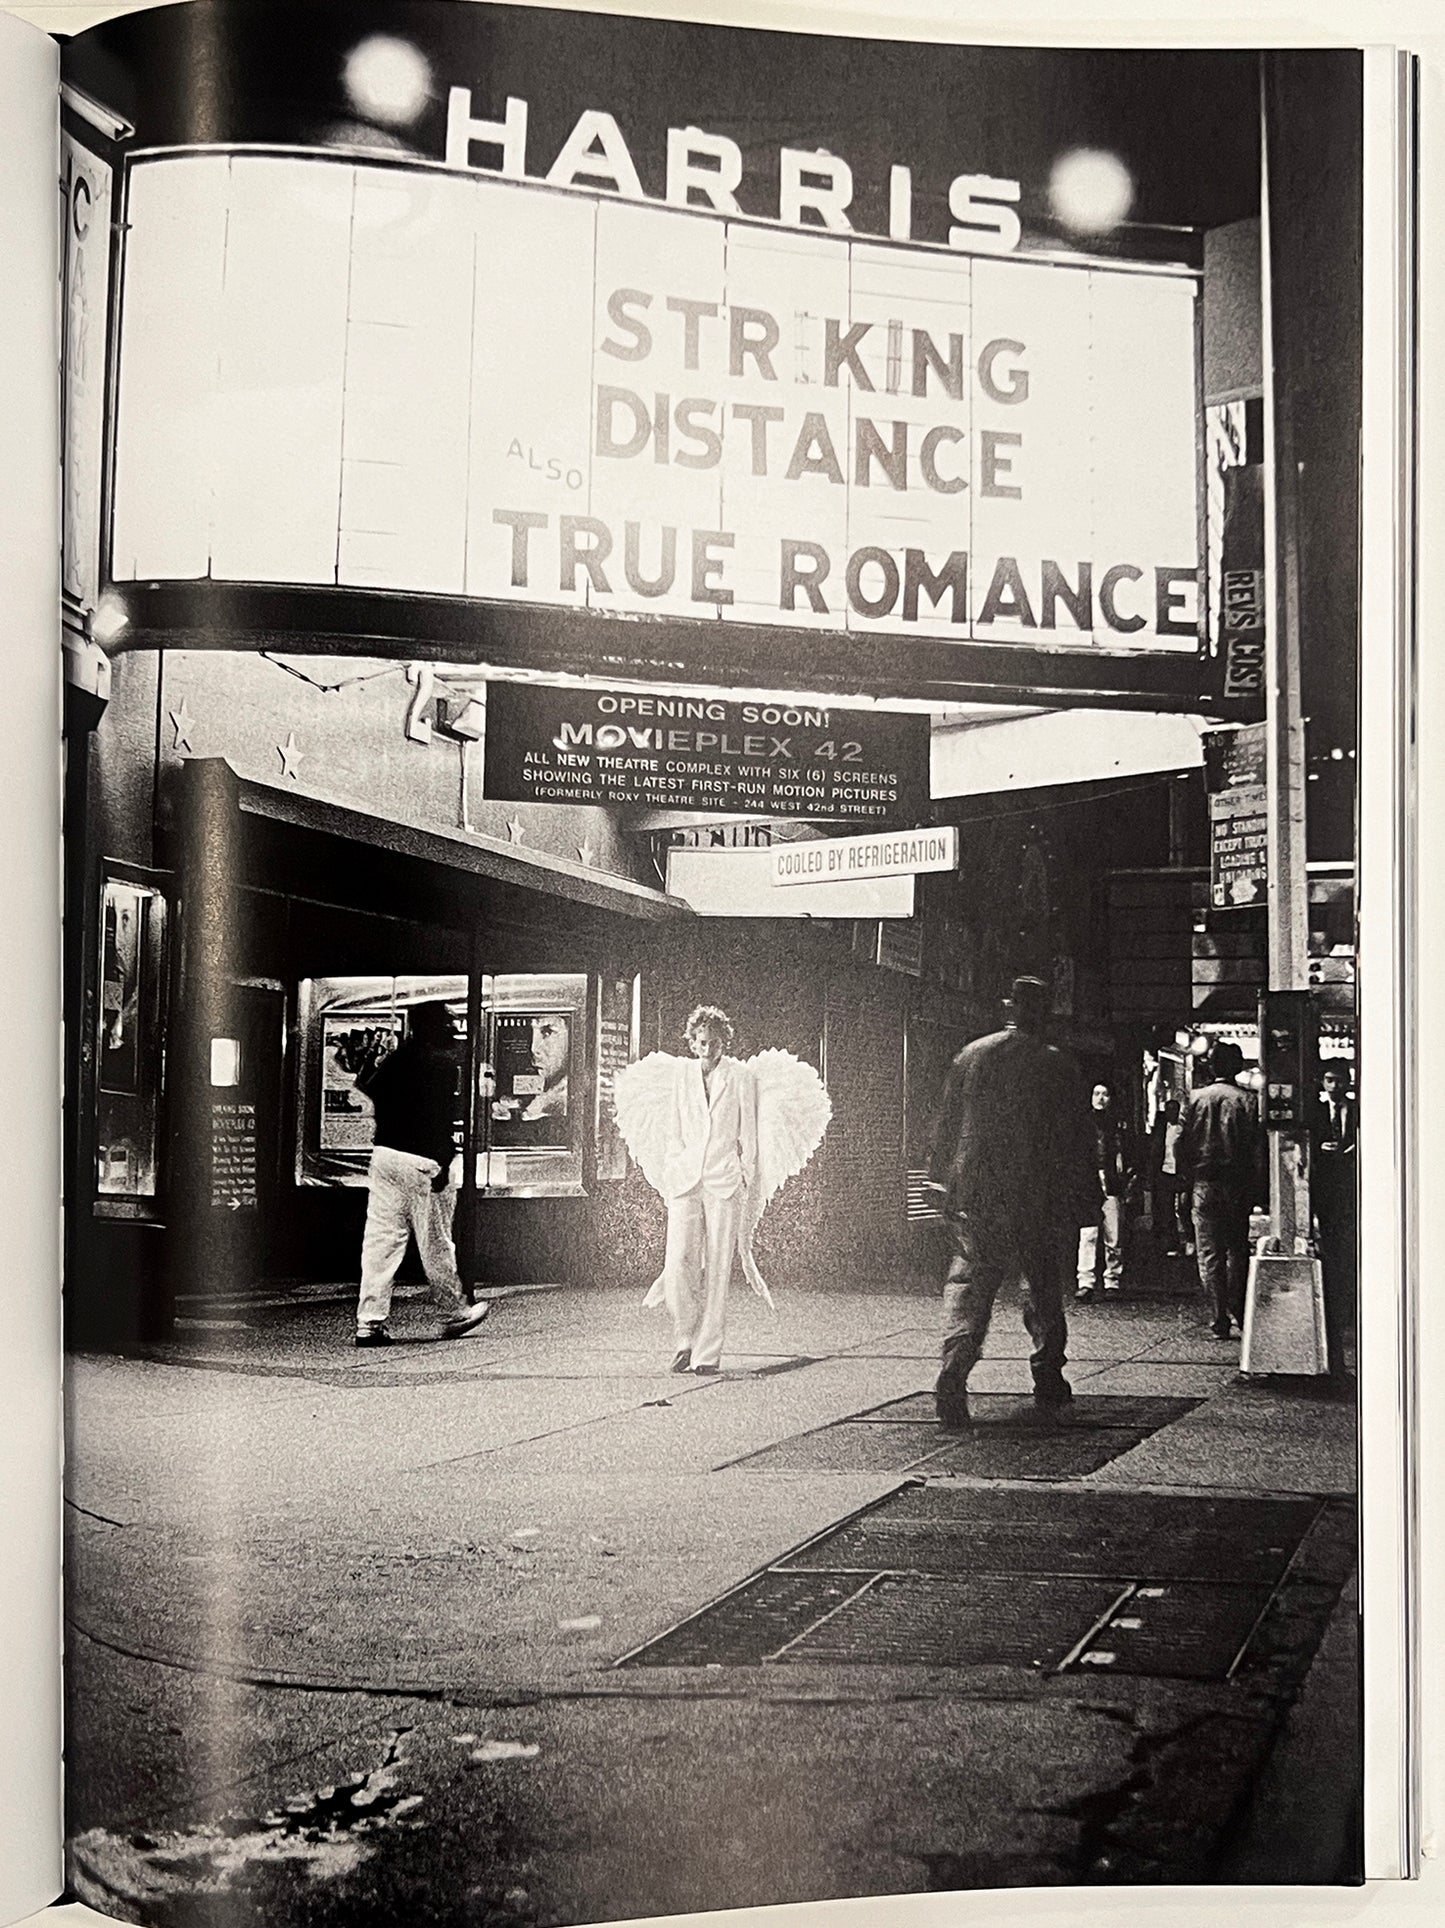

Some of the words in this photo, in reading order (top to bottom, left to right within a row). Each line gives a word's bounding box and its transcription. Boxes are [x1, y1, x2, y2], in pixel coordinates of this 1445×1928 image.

[445, 86, 1021, 252] HARRIS
[600, 288, 1029, 404] STRKING
[506, 437, 583, 490] ALSO
[595, 384, 1022, 499] DISTANCE
[493, 508, 736, 606] TRUE
[779, 538, 1198, 636] ROMANCE
[1227, 571, 1256, 628] REVS
[598, 696, 726, 721] OPENING
[742, 706, 829, 728] SOON!
[559, 722, 792, 758] MOVIEPLEX
[814, 740, 863, 763] 42
[523, 769, 592, 784] SHOWING
[600, 774, 625, 787] THE
[634, 776, 684, 790] LATEST
[692, 779, 766, 794] FIRST-RUN
[773, 784, 825, 798] MOTION
[832, 787, 897, 801] PICTURES
[524, 751, 549, 764] ALL
[557, 753, 590, 767] NEW
[597, 756, 658, 771] THEATRE
[666, 761, 731, 776] COMPLEX
[738, 765, 771, 778] WITH
[778, 768, 799, 780] SIX
[806, 769, 826, 782] (6)
[833, 771, 897, 785] SCREENS
[535, 786, 602, 800] (FORMERLY
[608, 791, 640, 802] ROXY
[646, 793, 695, 806] THEATRE
[702, 797, 726, 807] SITE
[770, 801, 801, 812] WEST
[806, 803, 835, 813] 42nd
[840, 804, 887, 816] STREET)
[777, 852, 823, 876] COOLED
[828, 848, 844, 871] BY
[848, 837, 947, 870] REFRIGERATION
